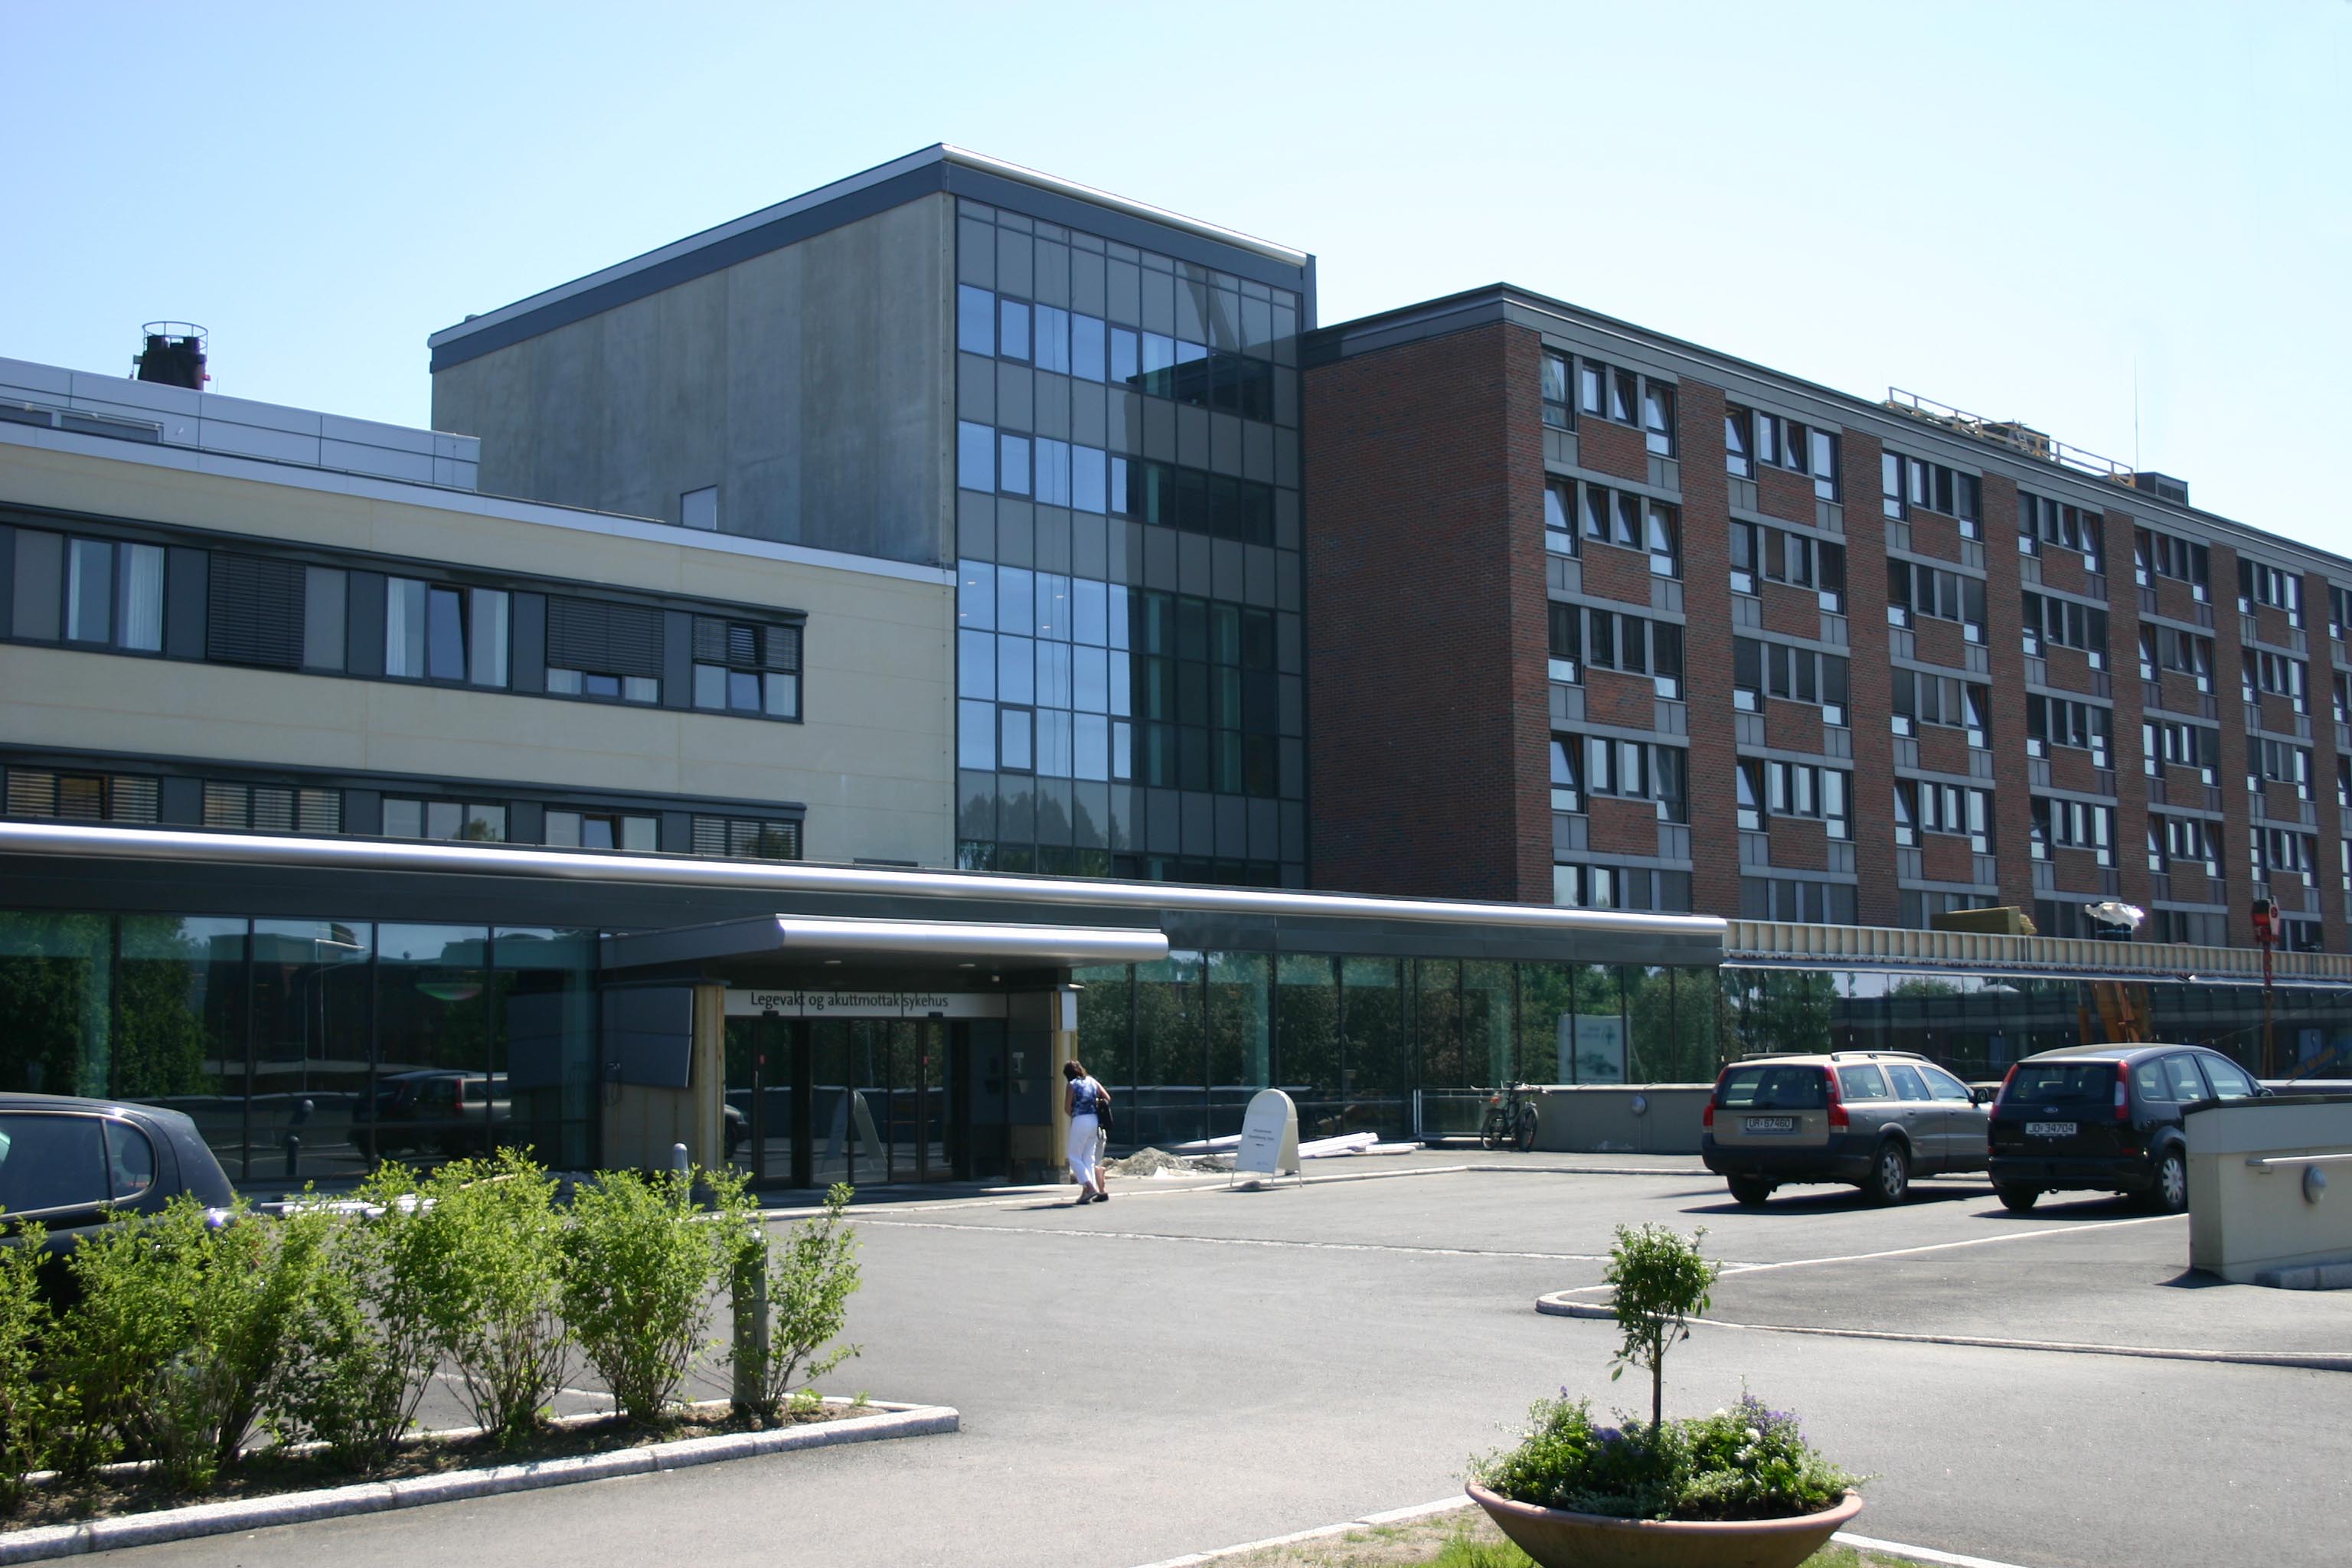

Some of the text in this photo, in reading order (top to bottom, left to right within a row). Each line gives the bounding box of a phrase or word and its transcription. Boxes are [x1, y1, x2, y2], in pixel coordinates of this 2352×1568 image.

[750, 991, 949, 1011] Legevakt og akuttmottak sykehus
